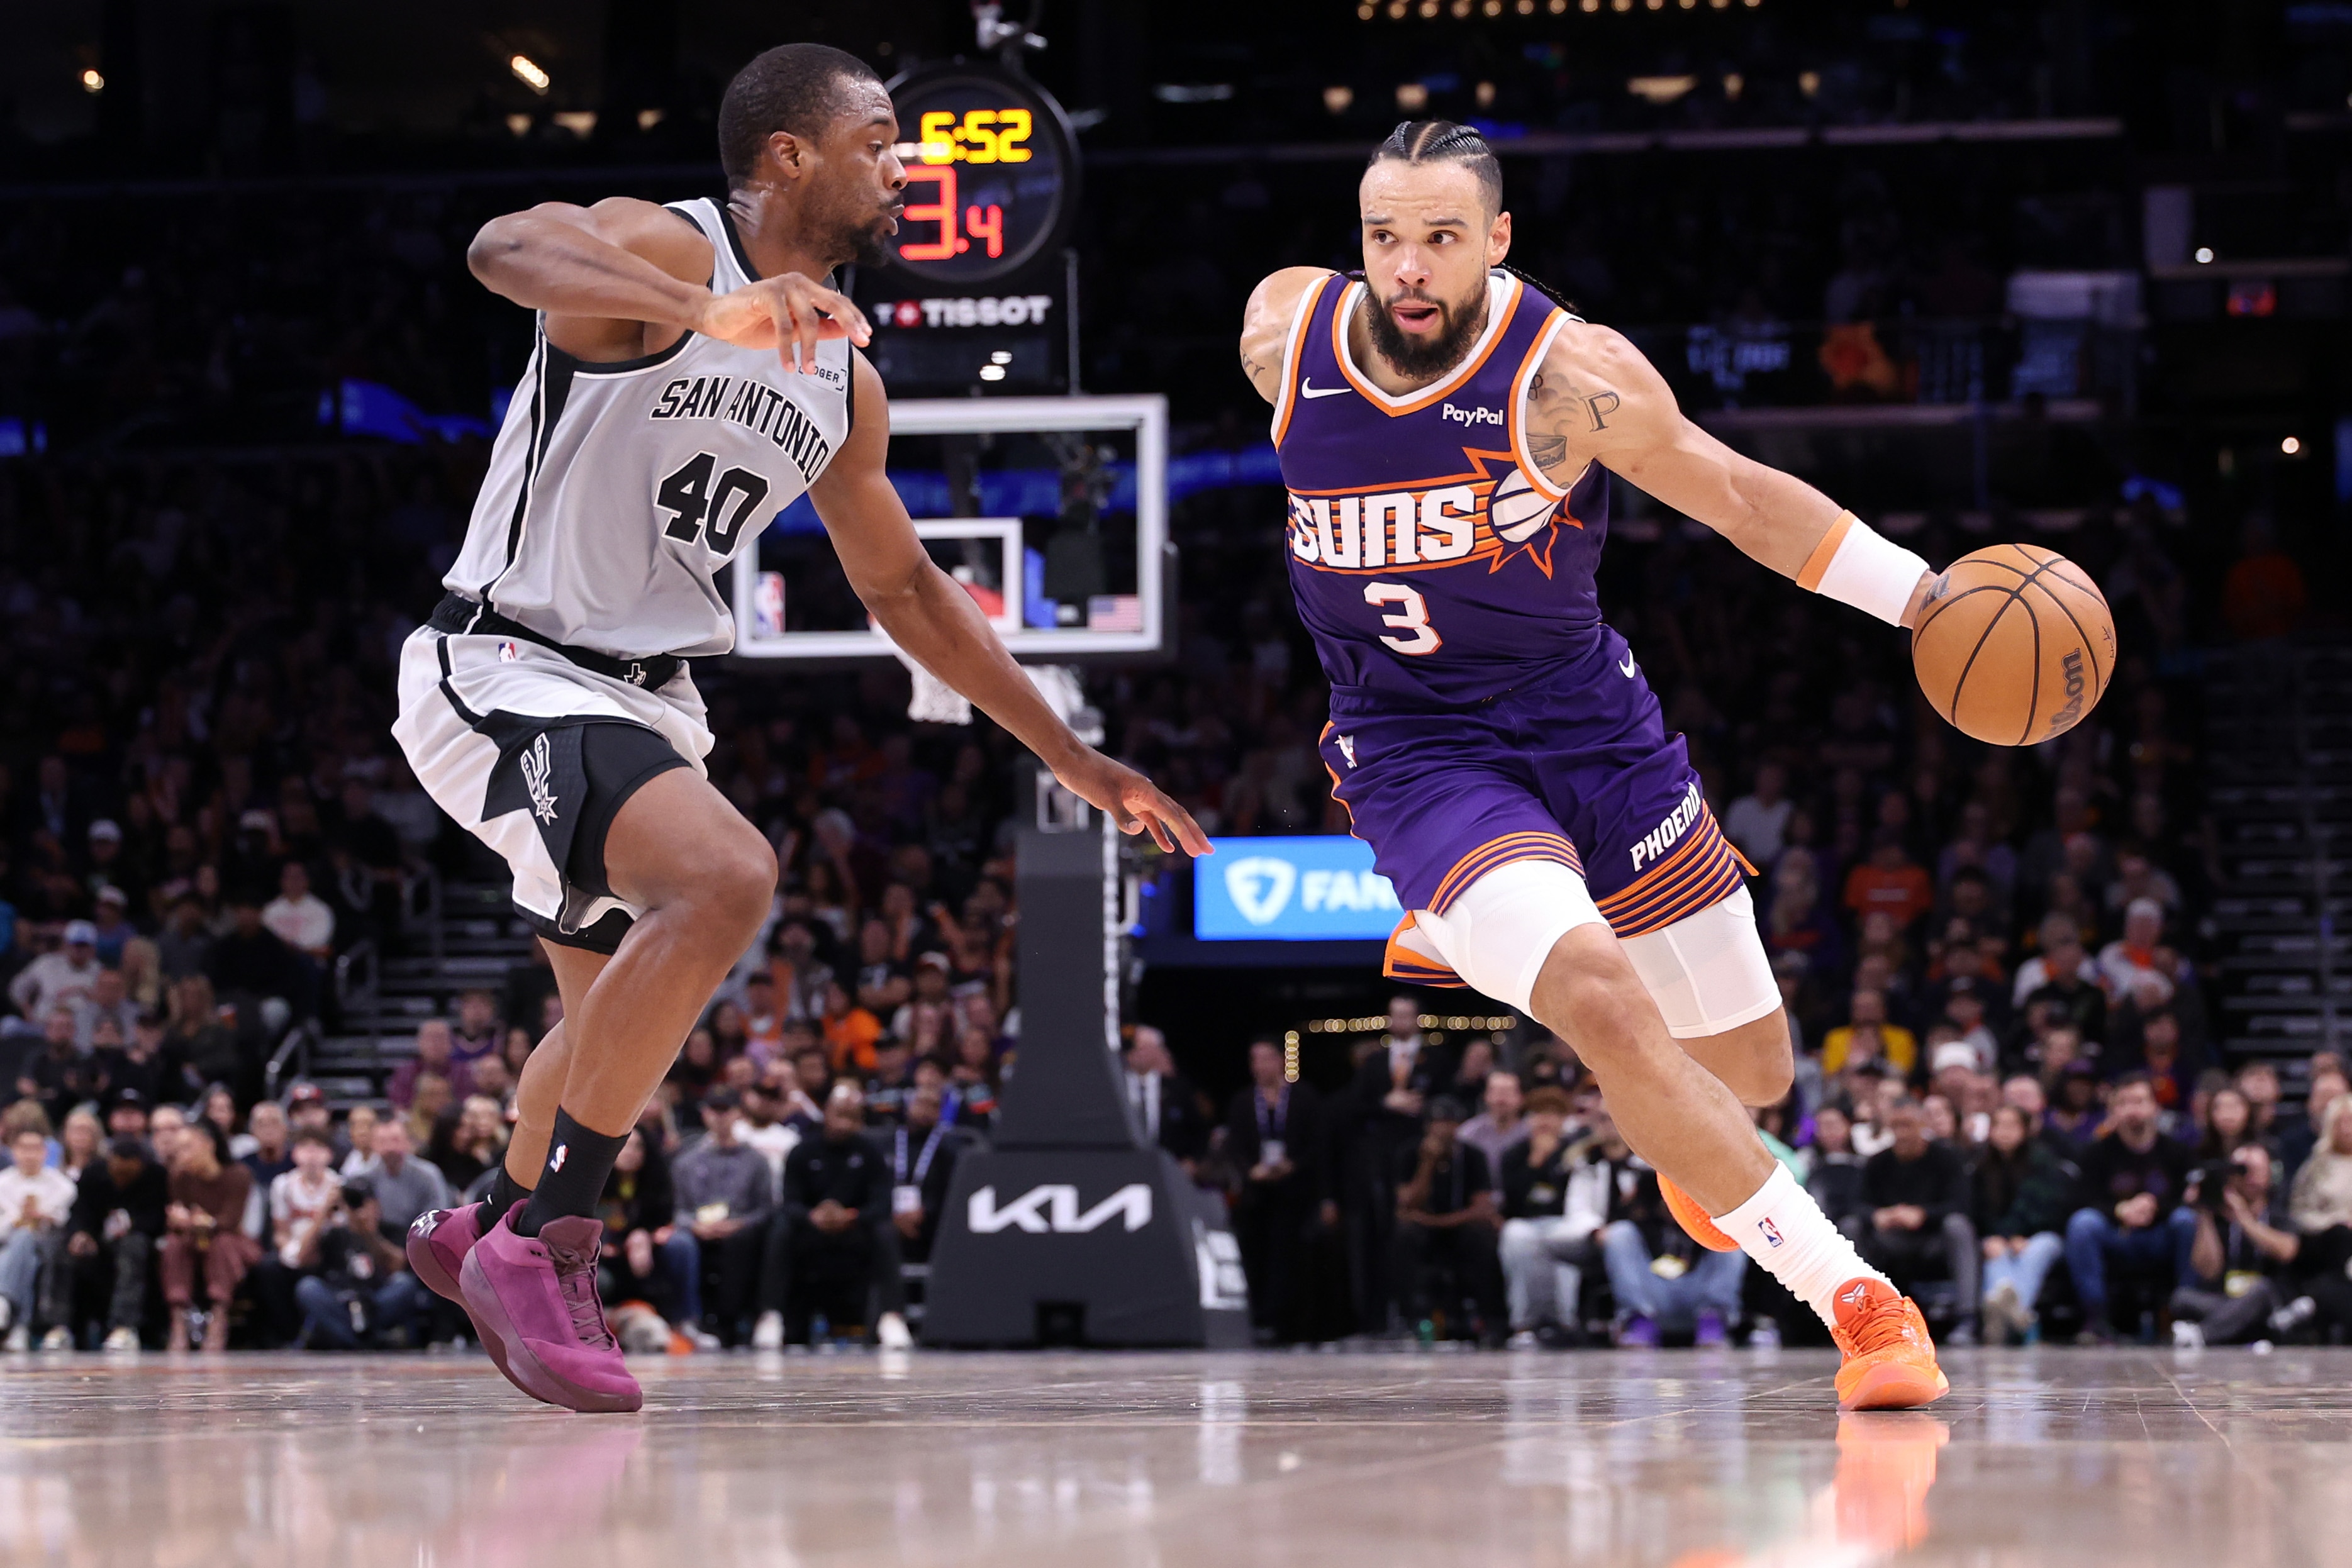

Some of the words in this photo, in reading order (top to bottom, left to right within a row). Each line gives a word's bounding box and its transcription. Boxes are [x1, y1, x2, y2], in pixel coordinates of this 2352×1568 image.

[921, 109, 1032, 165] 6:52
[900, 165, 1003, 260] 3.4
[919, 294, 1053, 328] TISSOT
[650, 376, 732, 420] SAN
[723, 379, 830, 487] ANTONIO
[1442, 403, 1503, 427] PayPal
[654, 450, 771, 558] 40
[1289, 485, 1475, 569] SUNS
[1364, 581, 1443, 655] 3
[2039, 647, 2085, 742] ilson
[1301, 870, 1404, 912] FAN
[967, 1184, 1153, 1233] KIA
